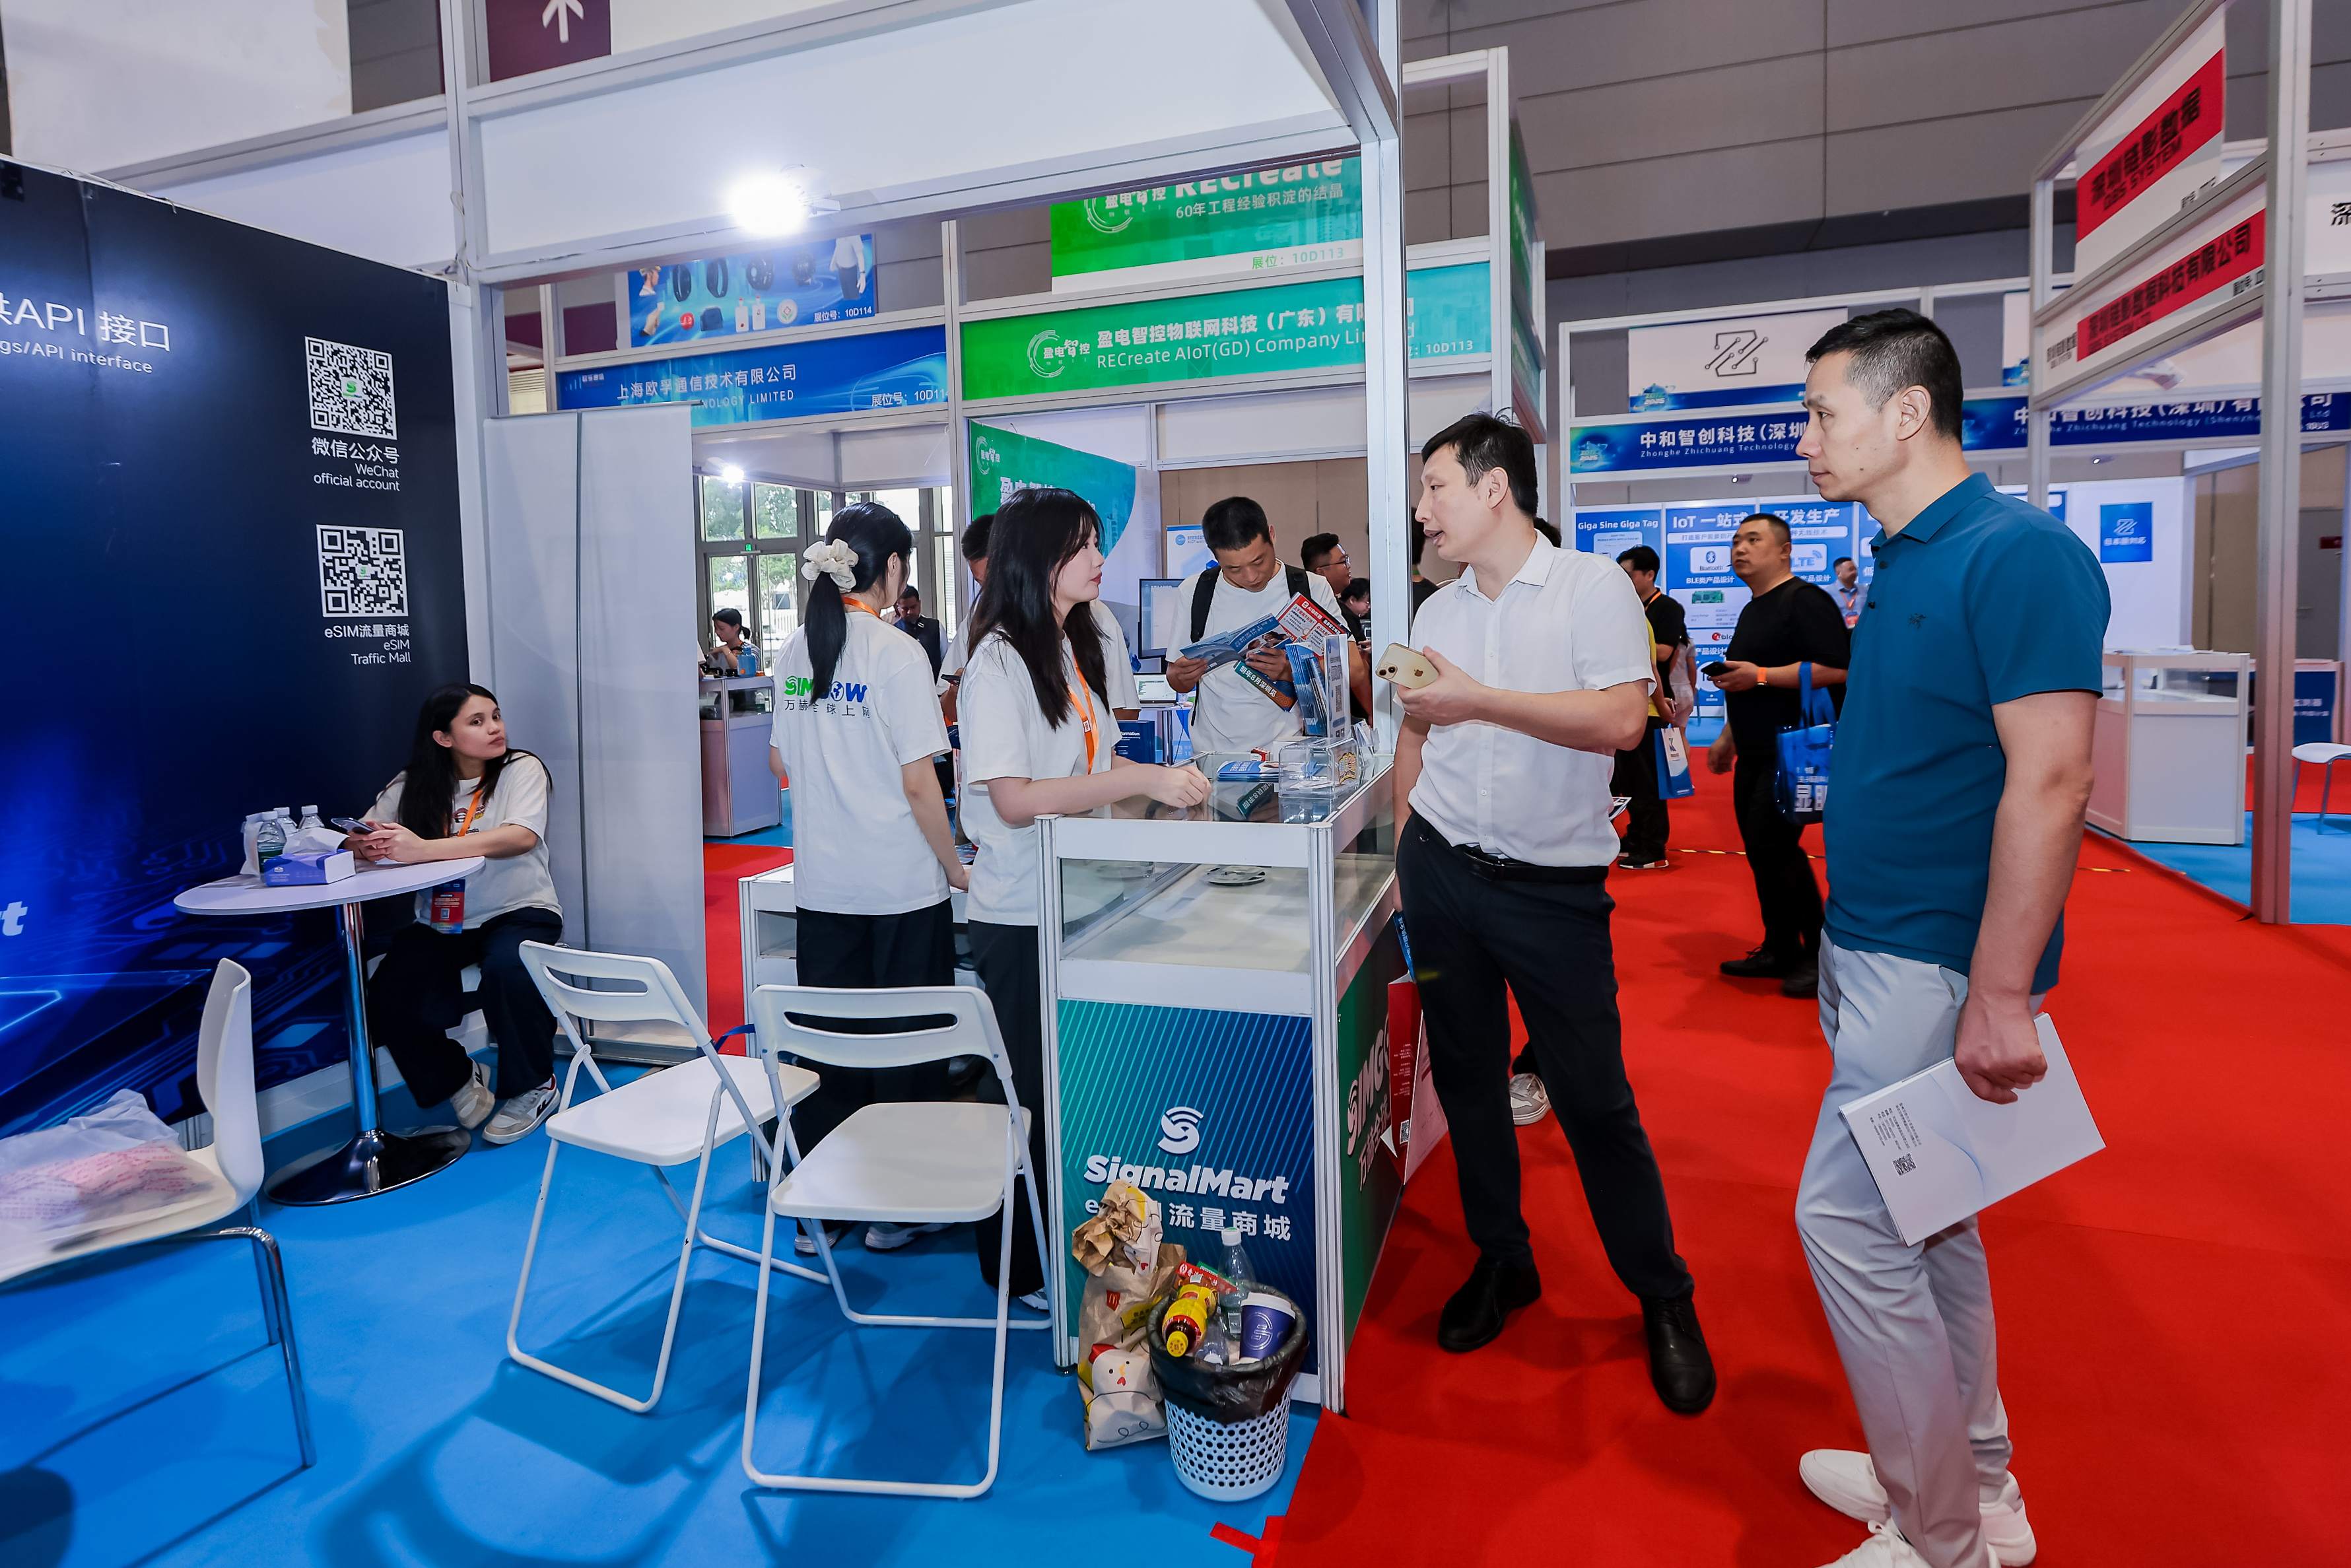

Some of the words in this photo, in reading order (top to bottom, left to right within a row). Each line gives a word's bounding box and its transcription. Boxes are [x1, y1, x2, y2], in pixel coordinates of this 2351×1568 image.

[1176, 183, 1344, 219] 60年工程经验积淀的结晶
[1293, 248, 1345, 265] 10D113
[845, 306, 872, 318] 10D114
[100, 310, 170, 353] 接口
[1097, 347, 1171, 368] RECreate
[1175, 339, 1251, 362] AIoT(GD)
[1256, 333, 1340, 353] Company
[1426, 339, 1474, 355] 10D113
[71, 348, 153, 374] interface
[617, 364, 796, 401] 上海欧孚通信技术有限公司
[749, 389, 794, 405] LIMITED
[312, 436, 400, 464] 微信公众号
[1641, 448, 1681, 458] Zhonghe
[1684, 446, 1735, 456] Zhichuang
[1739, 442, 1795, 452] Technology
[355, 463, 400, 479] WeChat
[313, 472, 353, 487] official
[355, 478, 400, 492] account
[1578, 522, 1598, 531] Giga
[1600, 520, 1619, 529] Sine
[1620, 520, 1641, 529] Giga
[1642, 519, 1659, 528] Tag
[1673, 515, 1697, 529] IoT
[324, 623, 410, 638] eSIM流量商城
[384, 639, 411, 651] eSIM
[351, 652, 386, 665] Traffic
[389, 652, 411, 664] Mall
[1239, 665, 1278, 698] 明年8月深圳见
[1083, 1154, 1289, 1204] SignalMart
